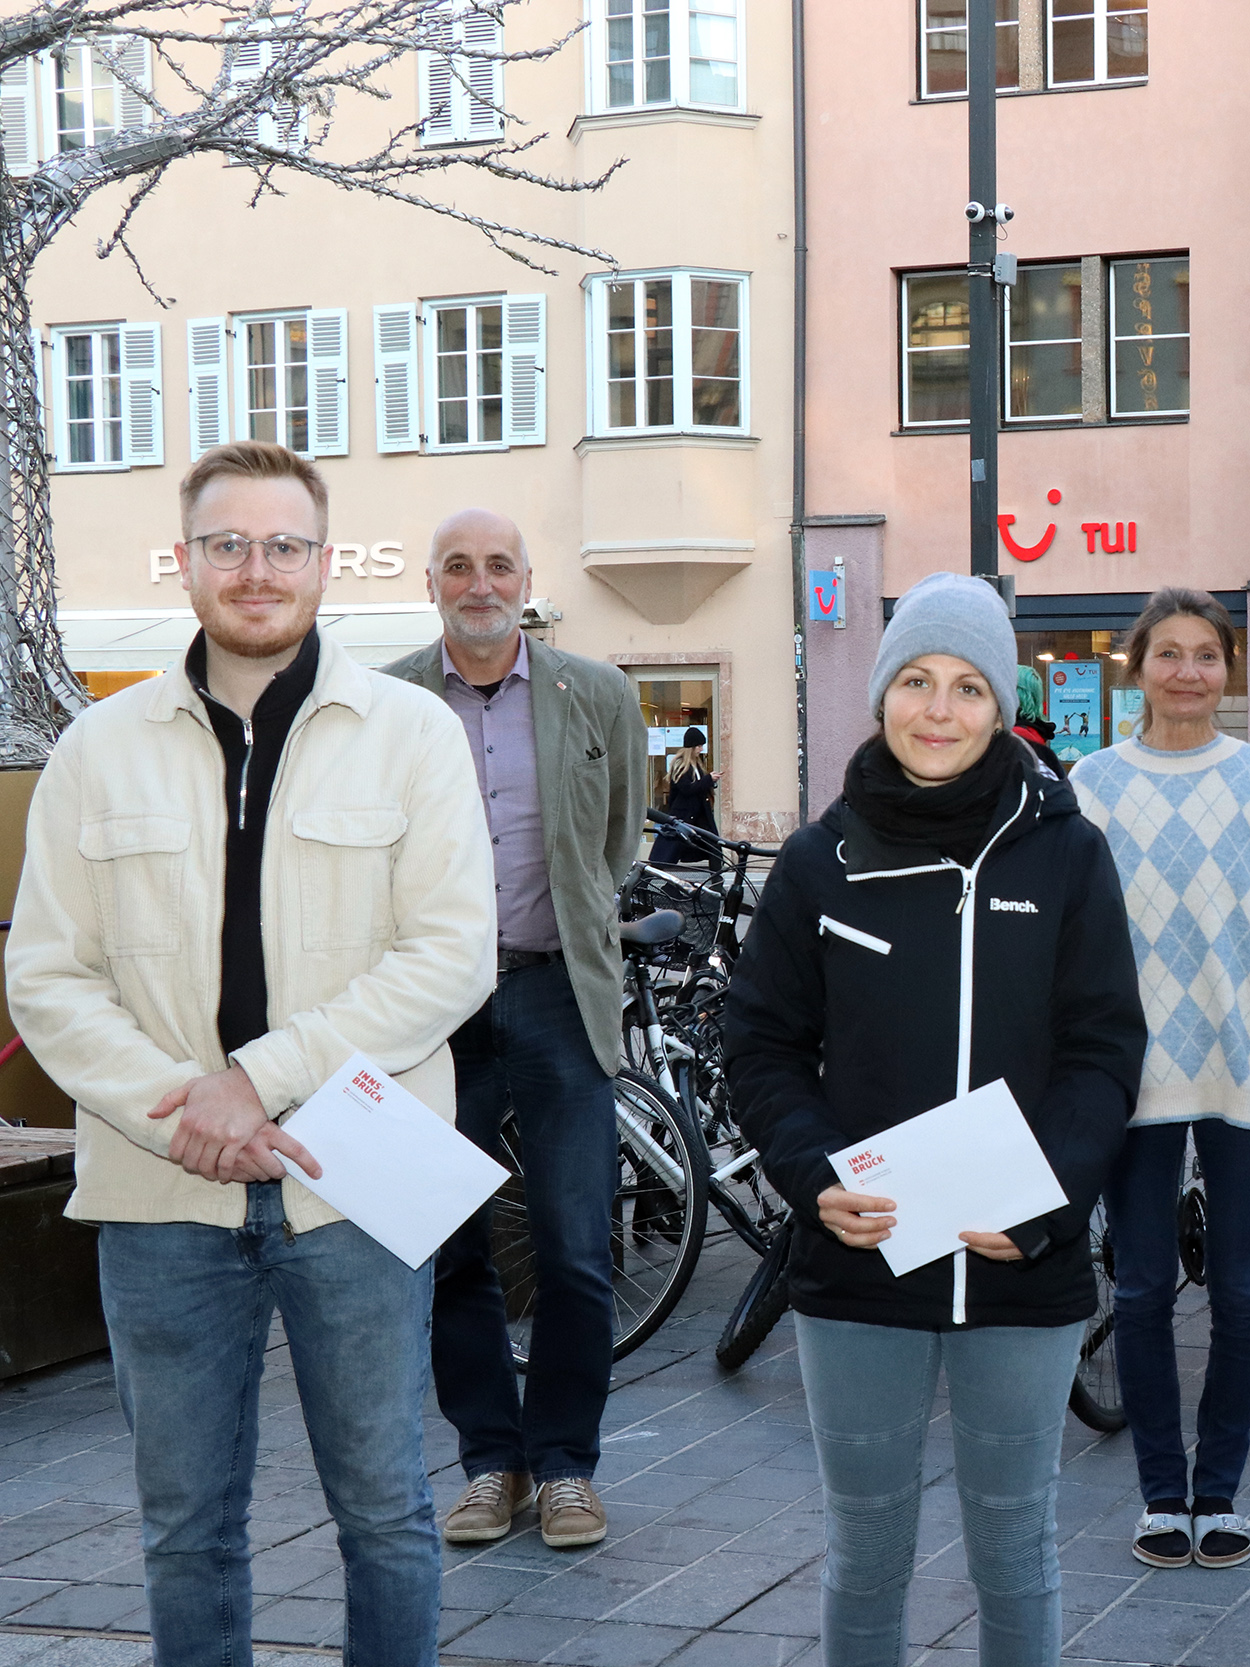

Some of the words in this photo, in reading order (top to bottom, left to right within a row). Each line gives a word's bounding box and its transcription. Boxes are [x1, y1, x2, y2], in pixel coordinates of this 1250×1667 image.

[1081, 521, 1137, 554] TUI
[989, 897, 1039, 914] Bench.
[352, 1076, 385, 1105] BRUCK
[852, 1154, 886, 1175] BRUCK
